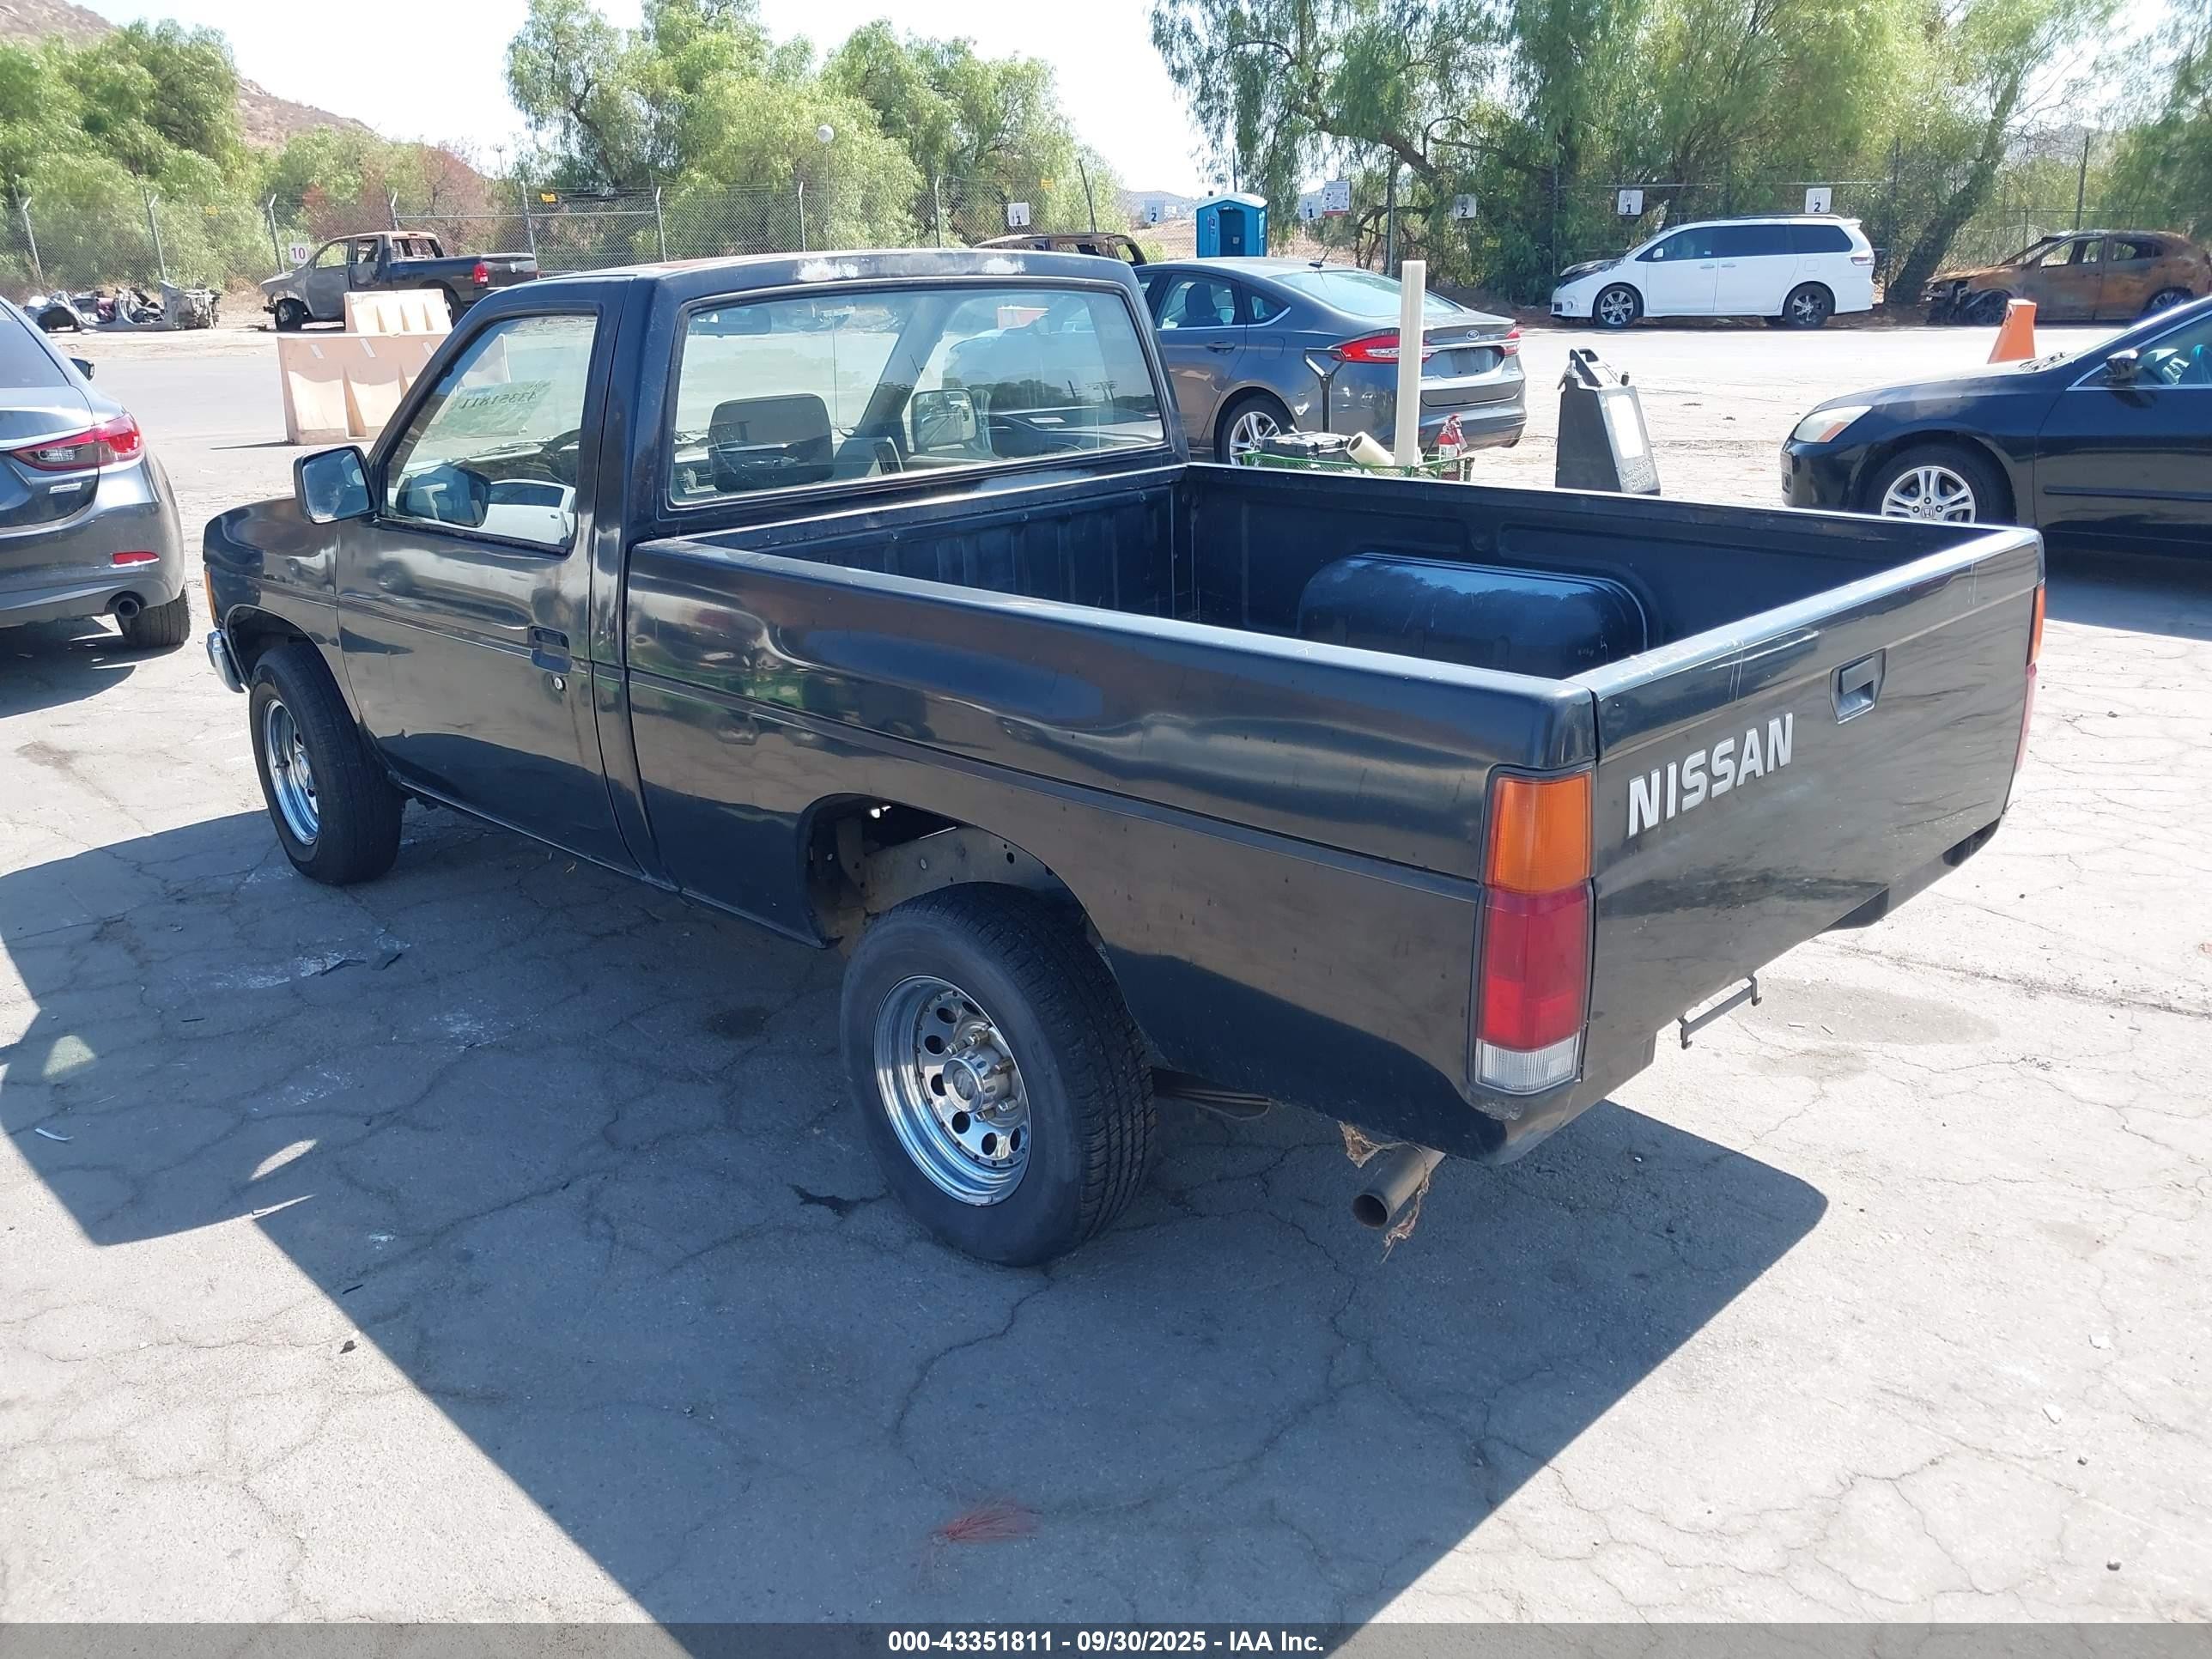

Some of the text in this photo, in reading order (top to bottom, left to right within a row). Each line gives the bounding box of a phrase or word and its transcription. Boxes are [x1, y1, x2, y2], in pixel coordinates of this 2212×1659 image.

[1461, 207, 1468, 216] 2
[1626, 204, 1632, 213] 1
[1814, 202, 1821, 213] 2
[1151, 212, 1158, 222] 2
[1308, 209, 1314, 218] 1
[1016, 215, 1022, 225] 1
[291, 247, 306, 259] 10
[1628, 713, 1793, 838] NISSAN
